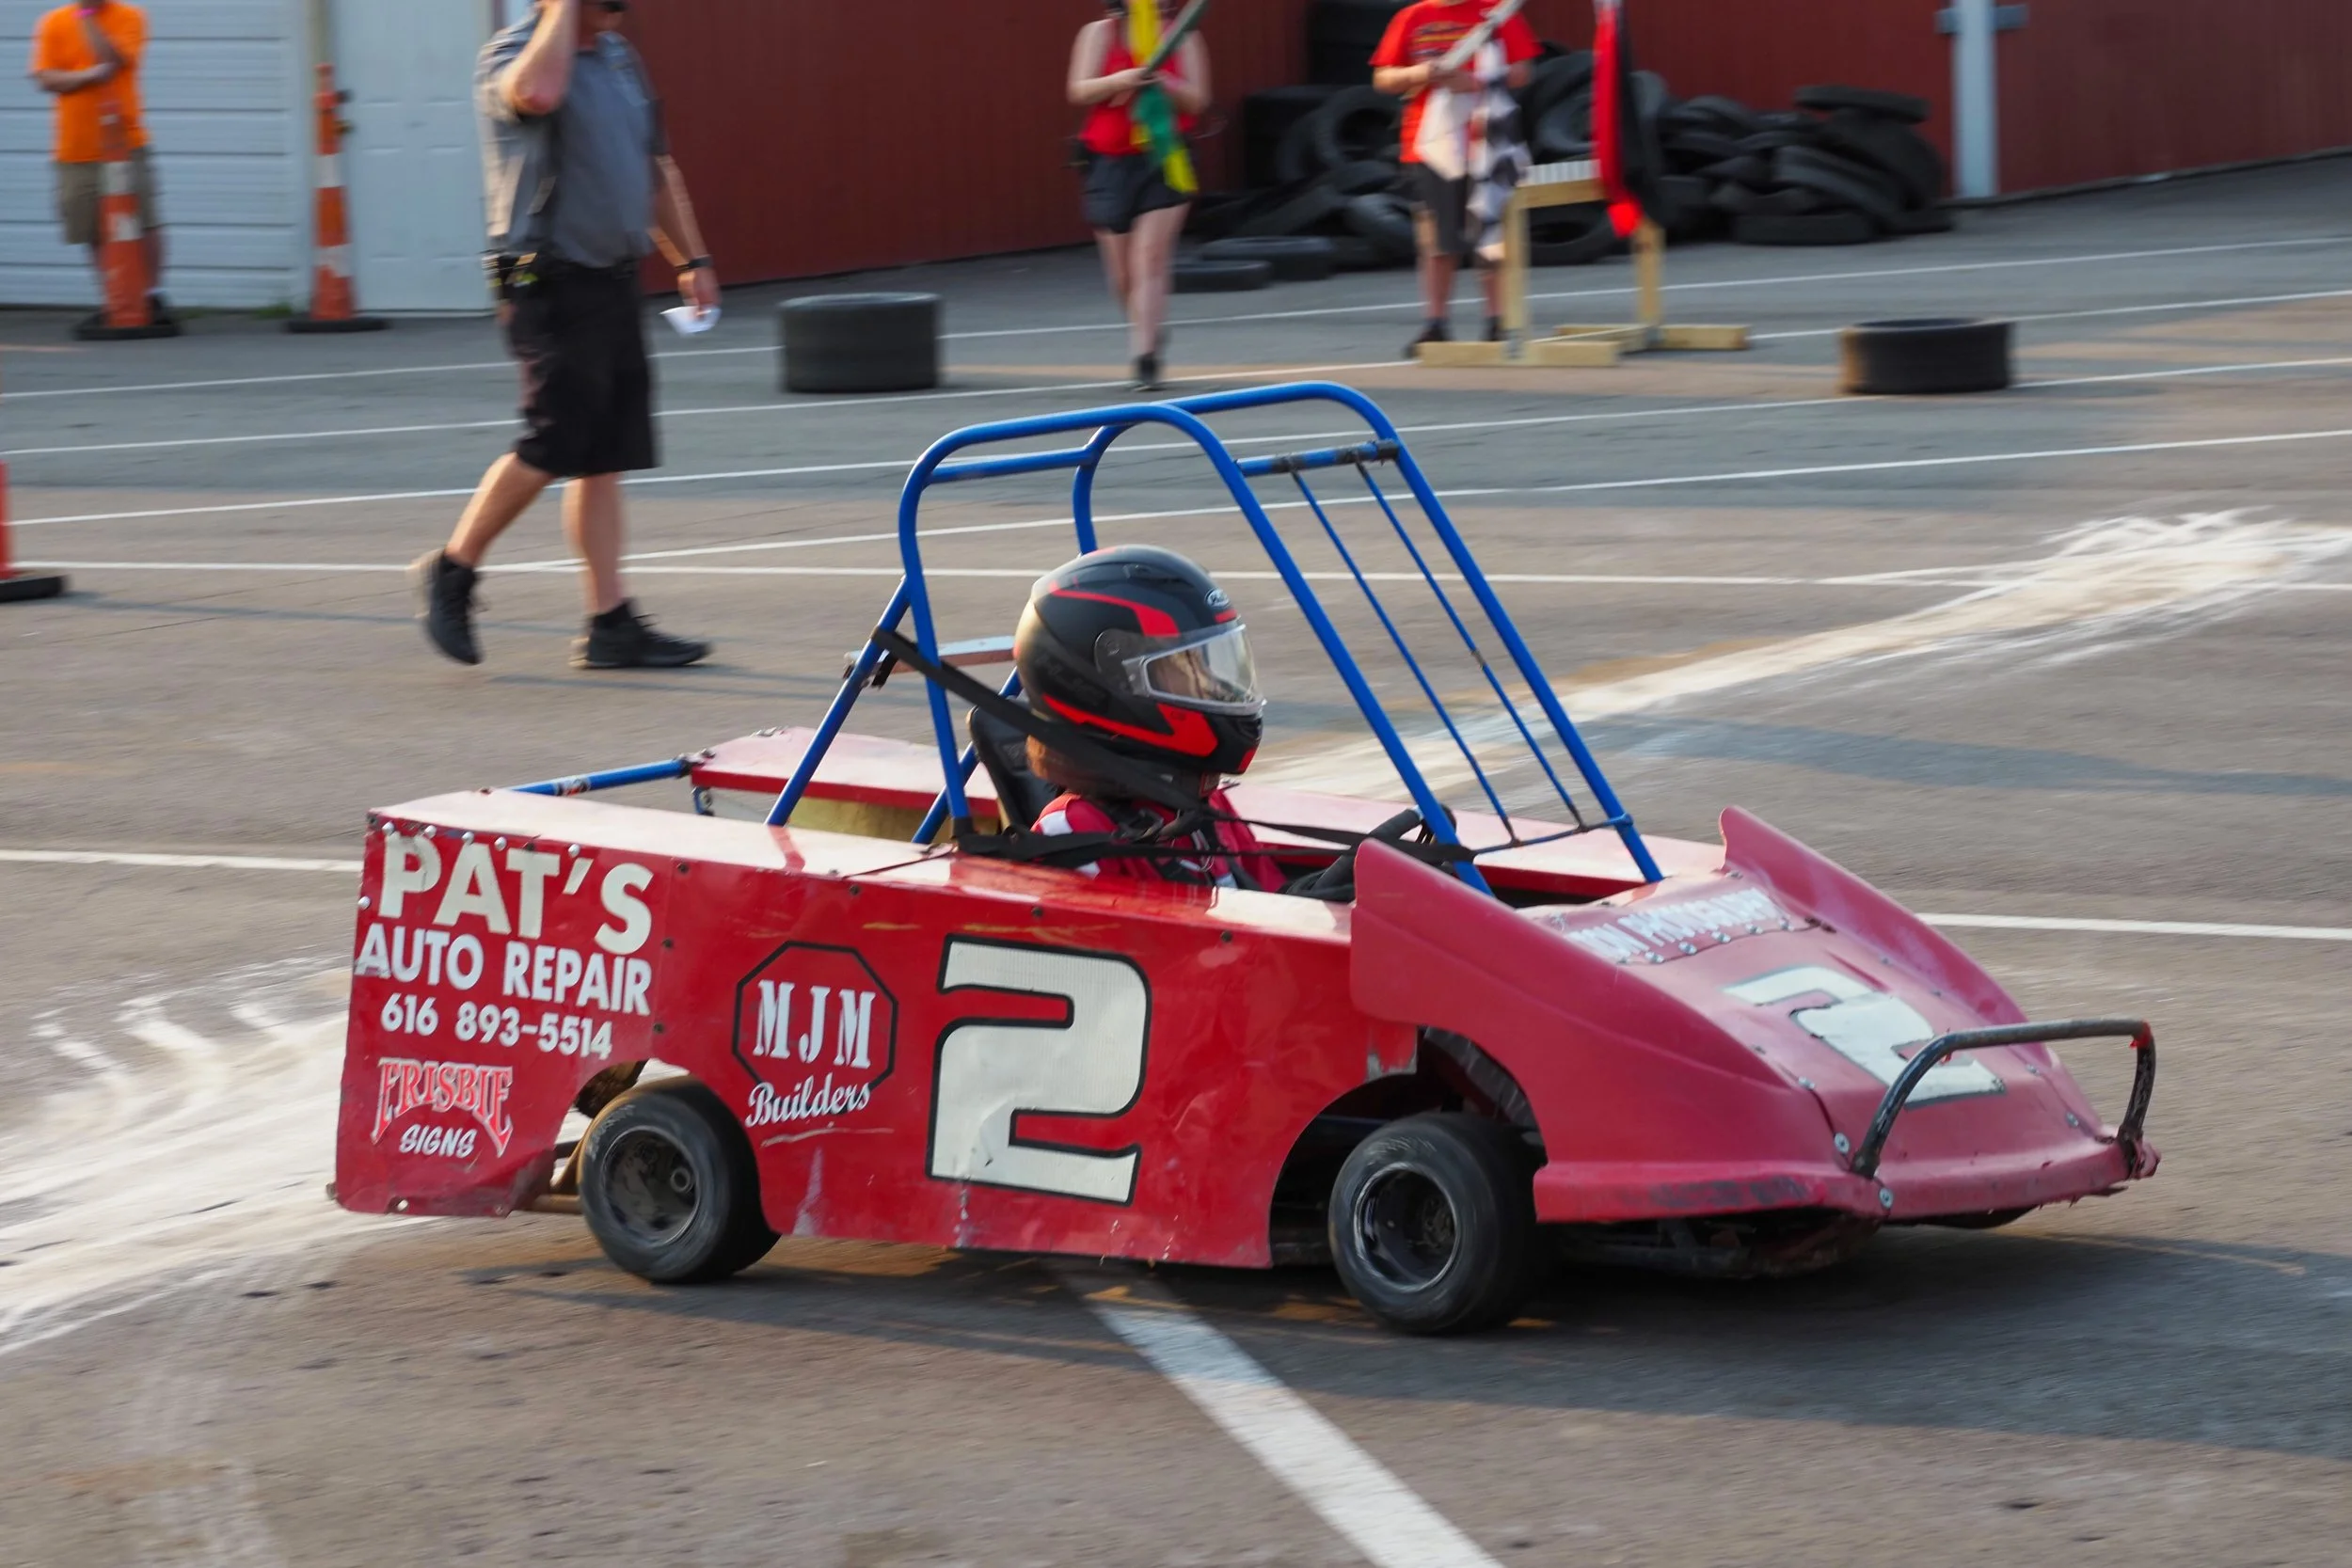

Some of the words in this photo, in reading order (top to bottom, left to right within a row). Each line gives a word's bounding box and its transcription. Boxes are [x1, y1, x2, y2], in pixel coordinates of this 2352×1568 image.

[378, 832, 654, 955] PAT'S
[355, 923, 484, 990] AUTO
[503, 942, 651, 1016] REPAIR
[381, 992, 439, 1036] 616
[455, 1002, 612, 1060] 893-5514
[926, 933, 1152, 1206] 2
[1723, 964, 2008, 1110] 2
[371, 1057, 514, 1158] FRISBIE
[399, 1124, 478, 1158] SIGNS
[745, 1073, 871, 1127] Builders
